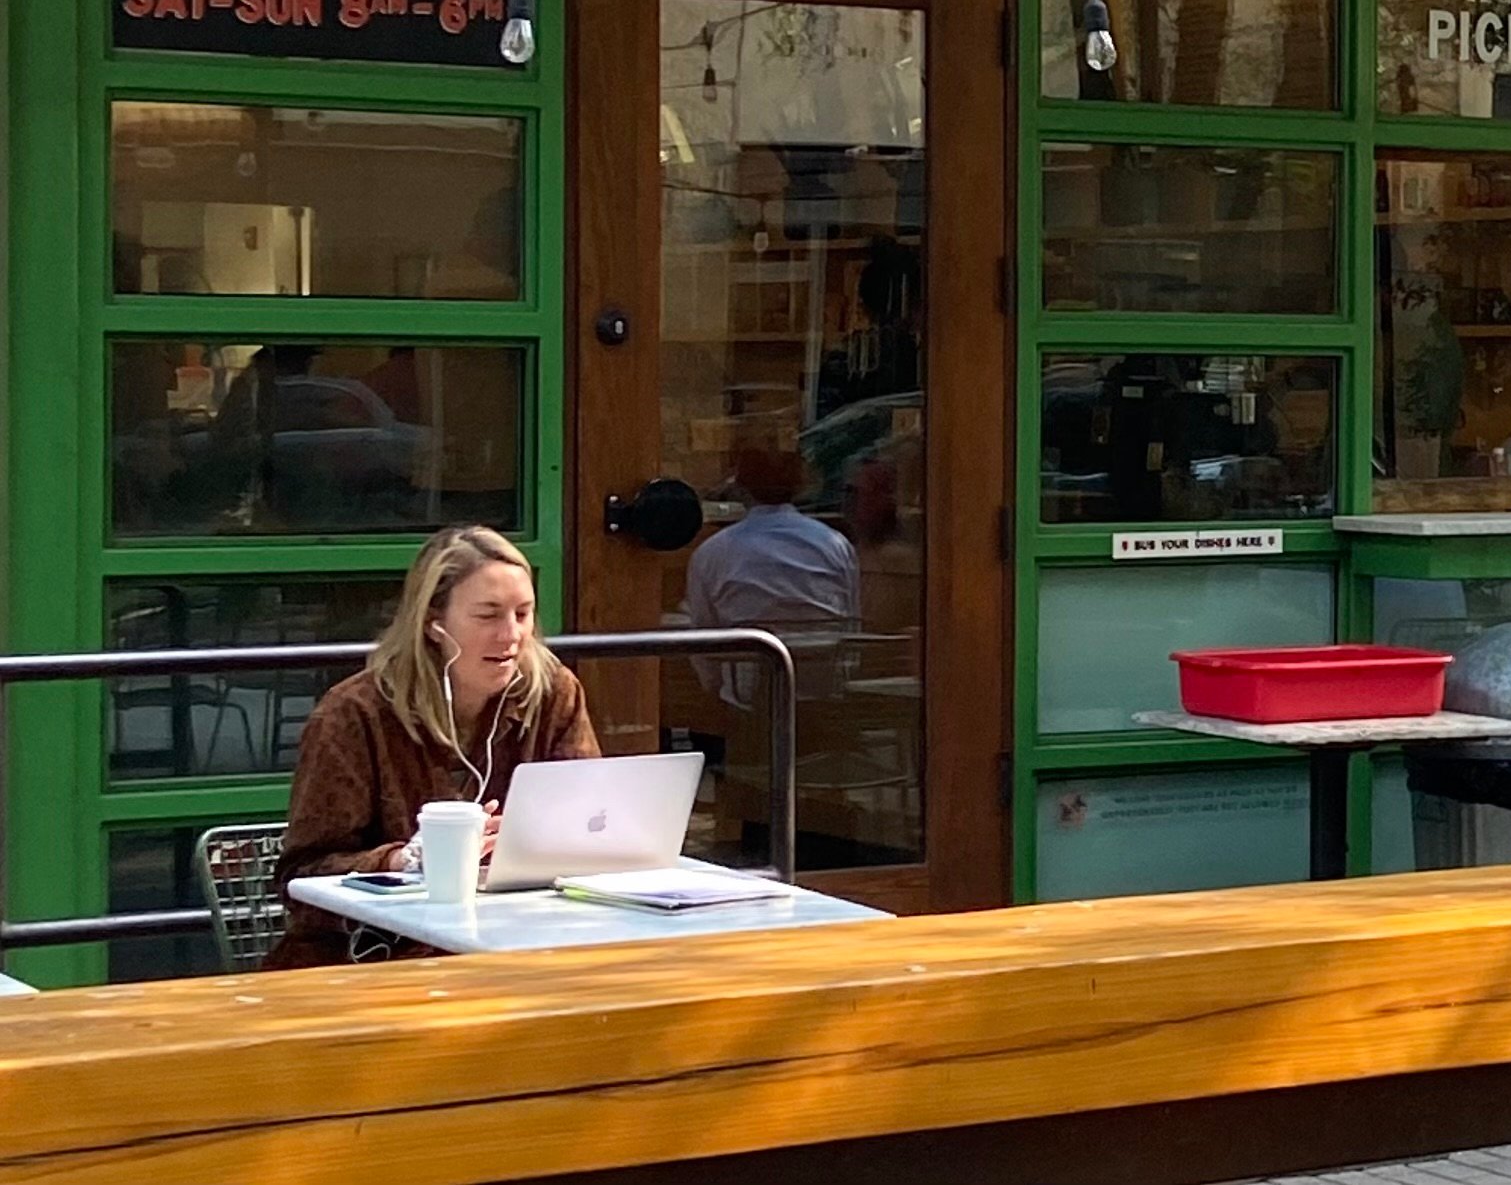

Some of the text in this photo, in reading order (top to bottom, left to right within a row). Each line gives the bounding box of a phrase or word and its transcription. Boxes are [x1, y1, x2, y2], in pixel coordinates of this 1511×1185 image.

[1134, 540, 1156, 551] BUS
[1161, 538, 1190, 551] YOUR
[1236, 535, 1263, 548] HERE
